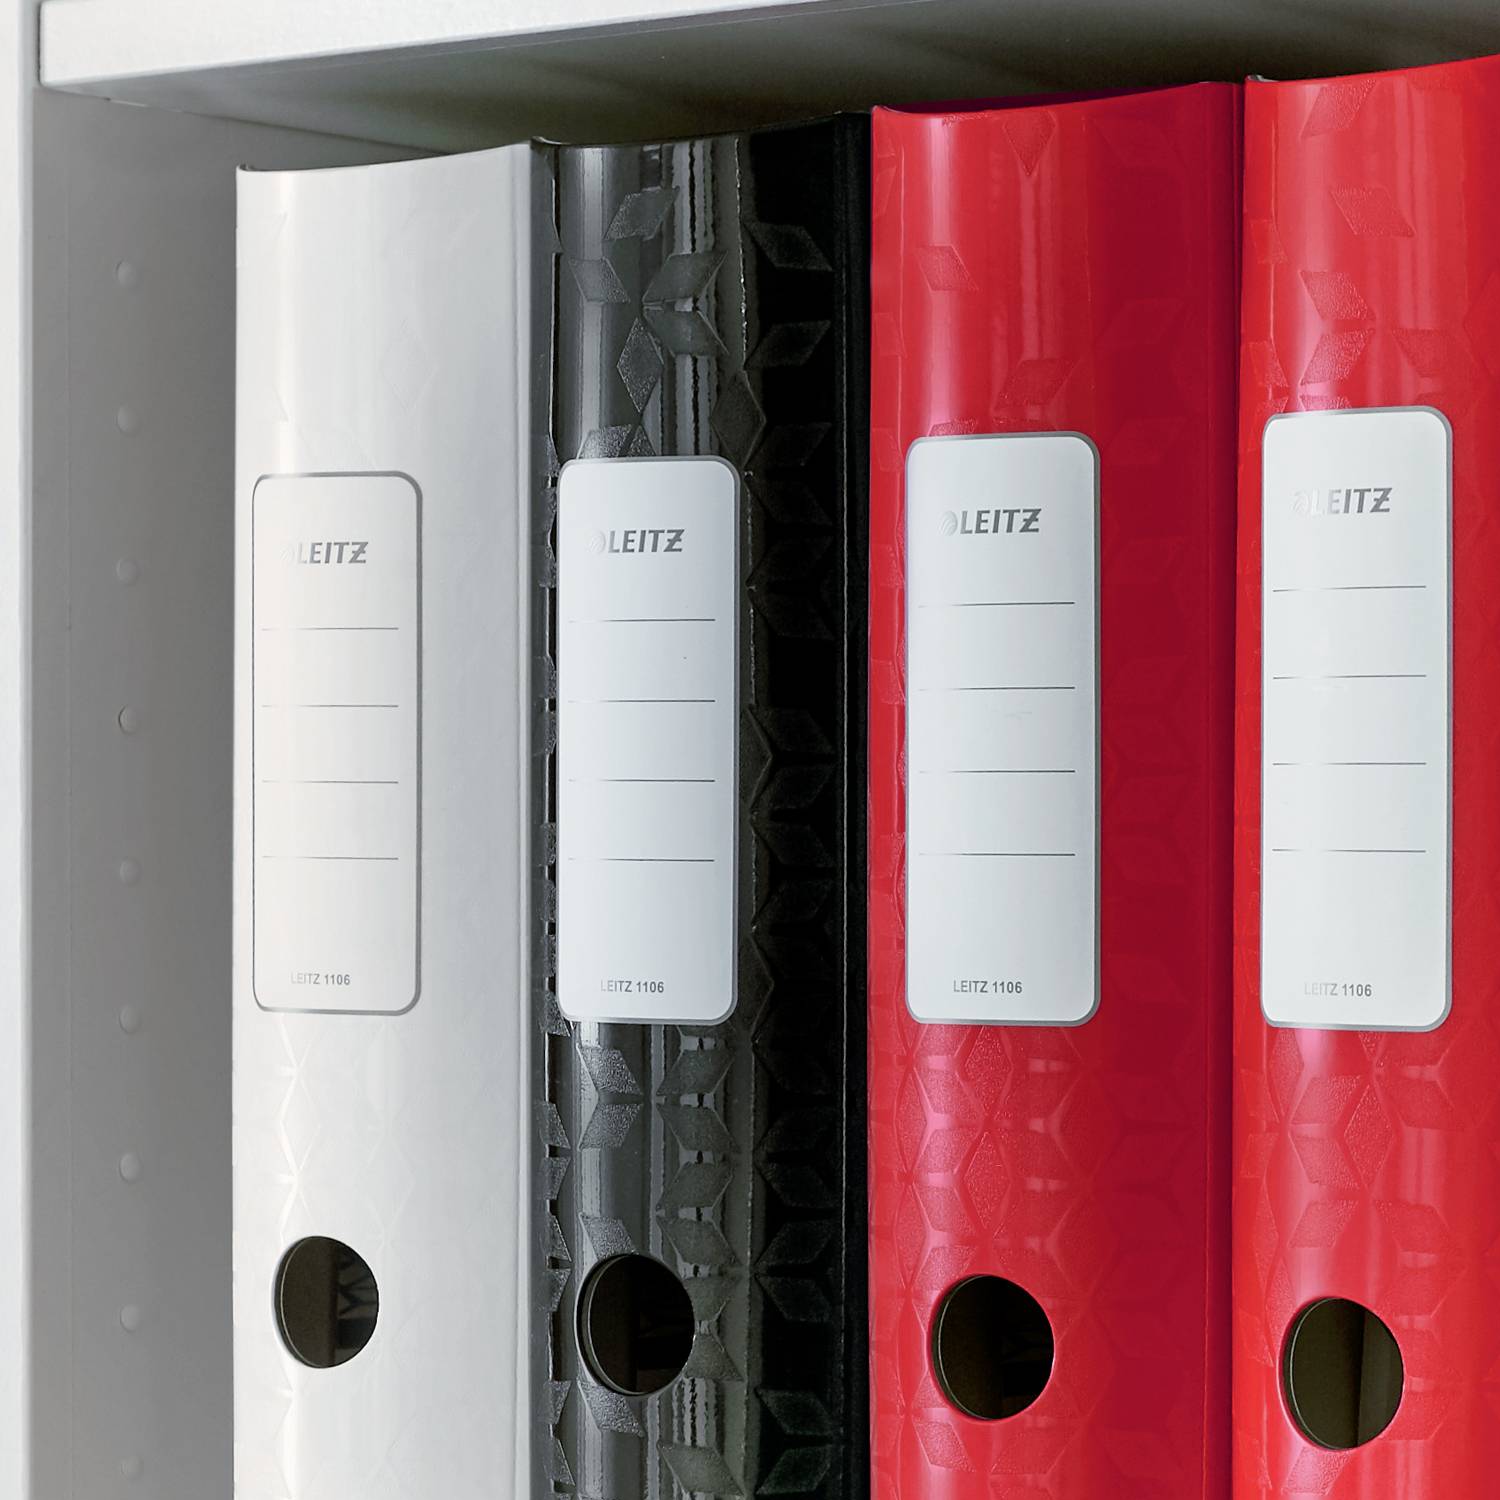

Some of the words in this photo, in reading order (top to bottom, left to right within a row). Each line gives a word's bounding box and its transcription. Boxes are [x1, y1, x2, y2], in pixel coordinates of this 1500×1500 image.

[960, 508, 1042, 535] LEITZ
[607, 528, 685, 553] LEITZ
[324, 973, 351, 986] 1106
[600, 979, 633, 993] LEITZ
[636, 980, 665, 994] 1106
[953, 979, 989, 994] LEITZ
[992, 980, 1023, 994] 1106
[1341, 983, 1372, 997] 1106
